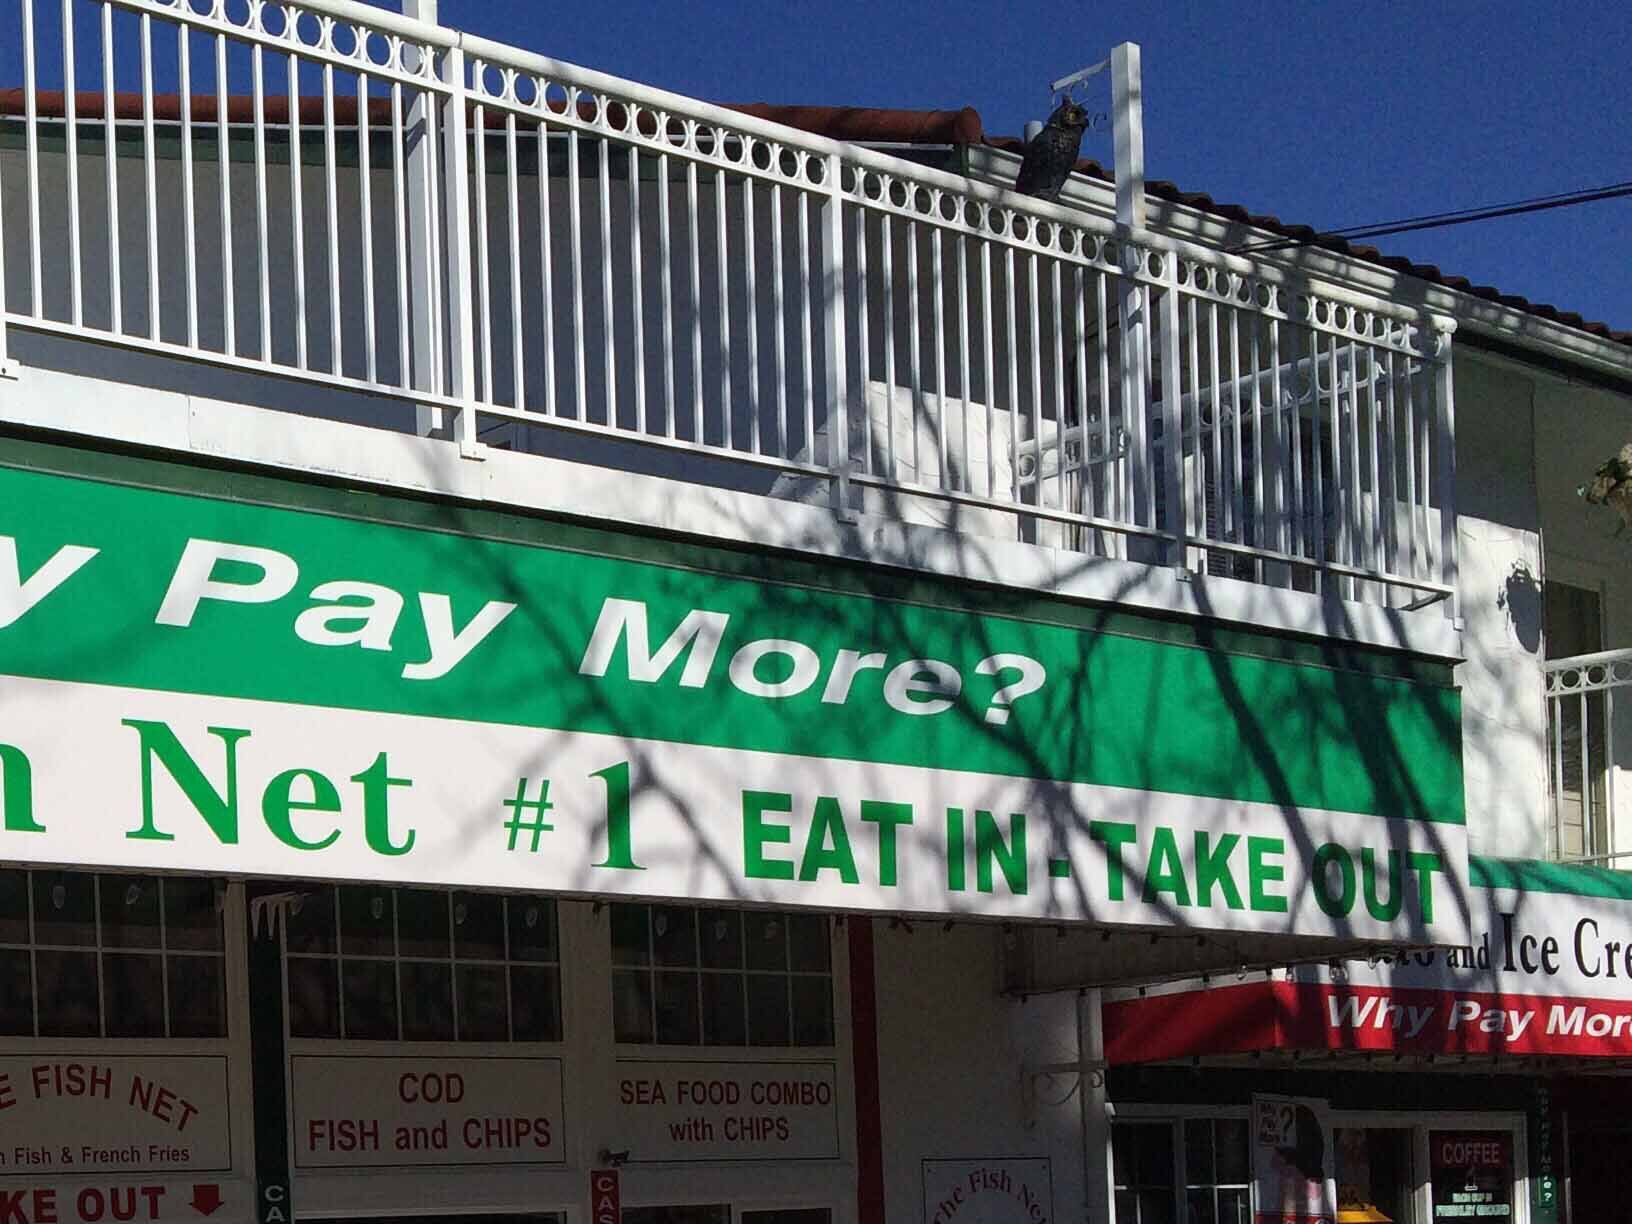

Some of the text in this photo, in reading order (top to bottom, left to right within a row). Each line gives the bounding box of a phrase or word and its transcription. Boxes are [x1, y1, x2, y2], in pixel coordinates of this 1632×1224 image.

[154, 538, 518, 680] Pay
[577, 596, 1047, 726] More?
[120, 717, 416, 856] Net
[741, 788, 914, 887] EAT
[946, 806, 1028, 895] IN
[1089, 820, 1288, 914] TAKE
[1311, 840, 1444, 925] OUT
[1446, 932, 1491, 970] and
[1502, 912, 1560, 975] Ice
[1327, 995, 1434, 1039] Why
[1447, 1000, 1535, 1043] Pay
[31, 1063, 112, 1099] FISH
[128, 1075, 199, 1132] NET
[398, 1072, 465, 1103] COD
[620, 1080, 832, 1106] SEA FOOD COMBO
[308, 1117, 552, 1151] FISH and CHIPS
[669, 1116, 790, 1144] with CHIPS
[14, 1146, 52, 1166] Fish
[60, 1147, 73, 1164] &
[81, 1145, 141, 1164] French
[148, 1145, 190, 1163] Fries
[1441, 1142, 1500, 1165] COFFEE
[968, 1167, 1012, 1194] Fish
[76, 1185, 166, 1222] OUT
